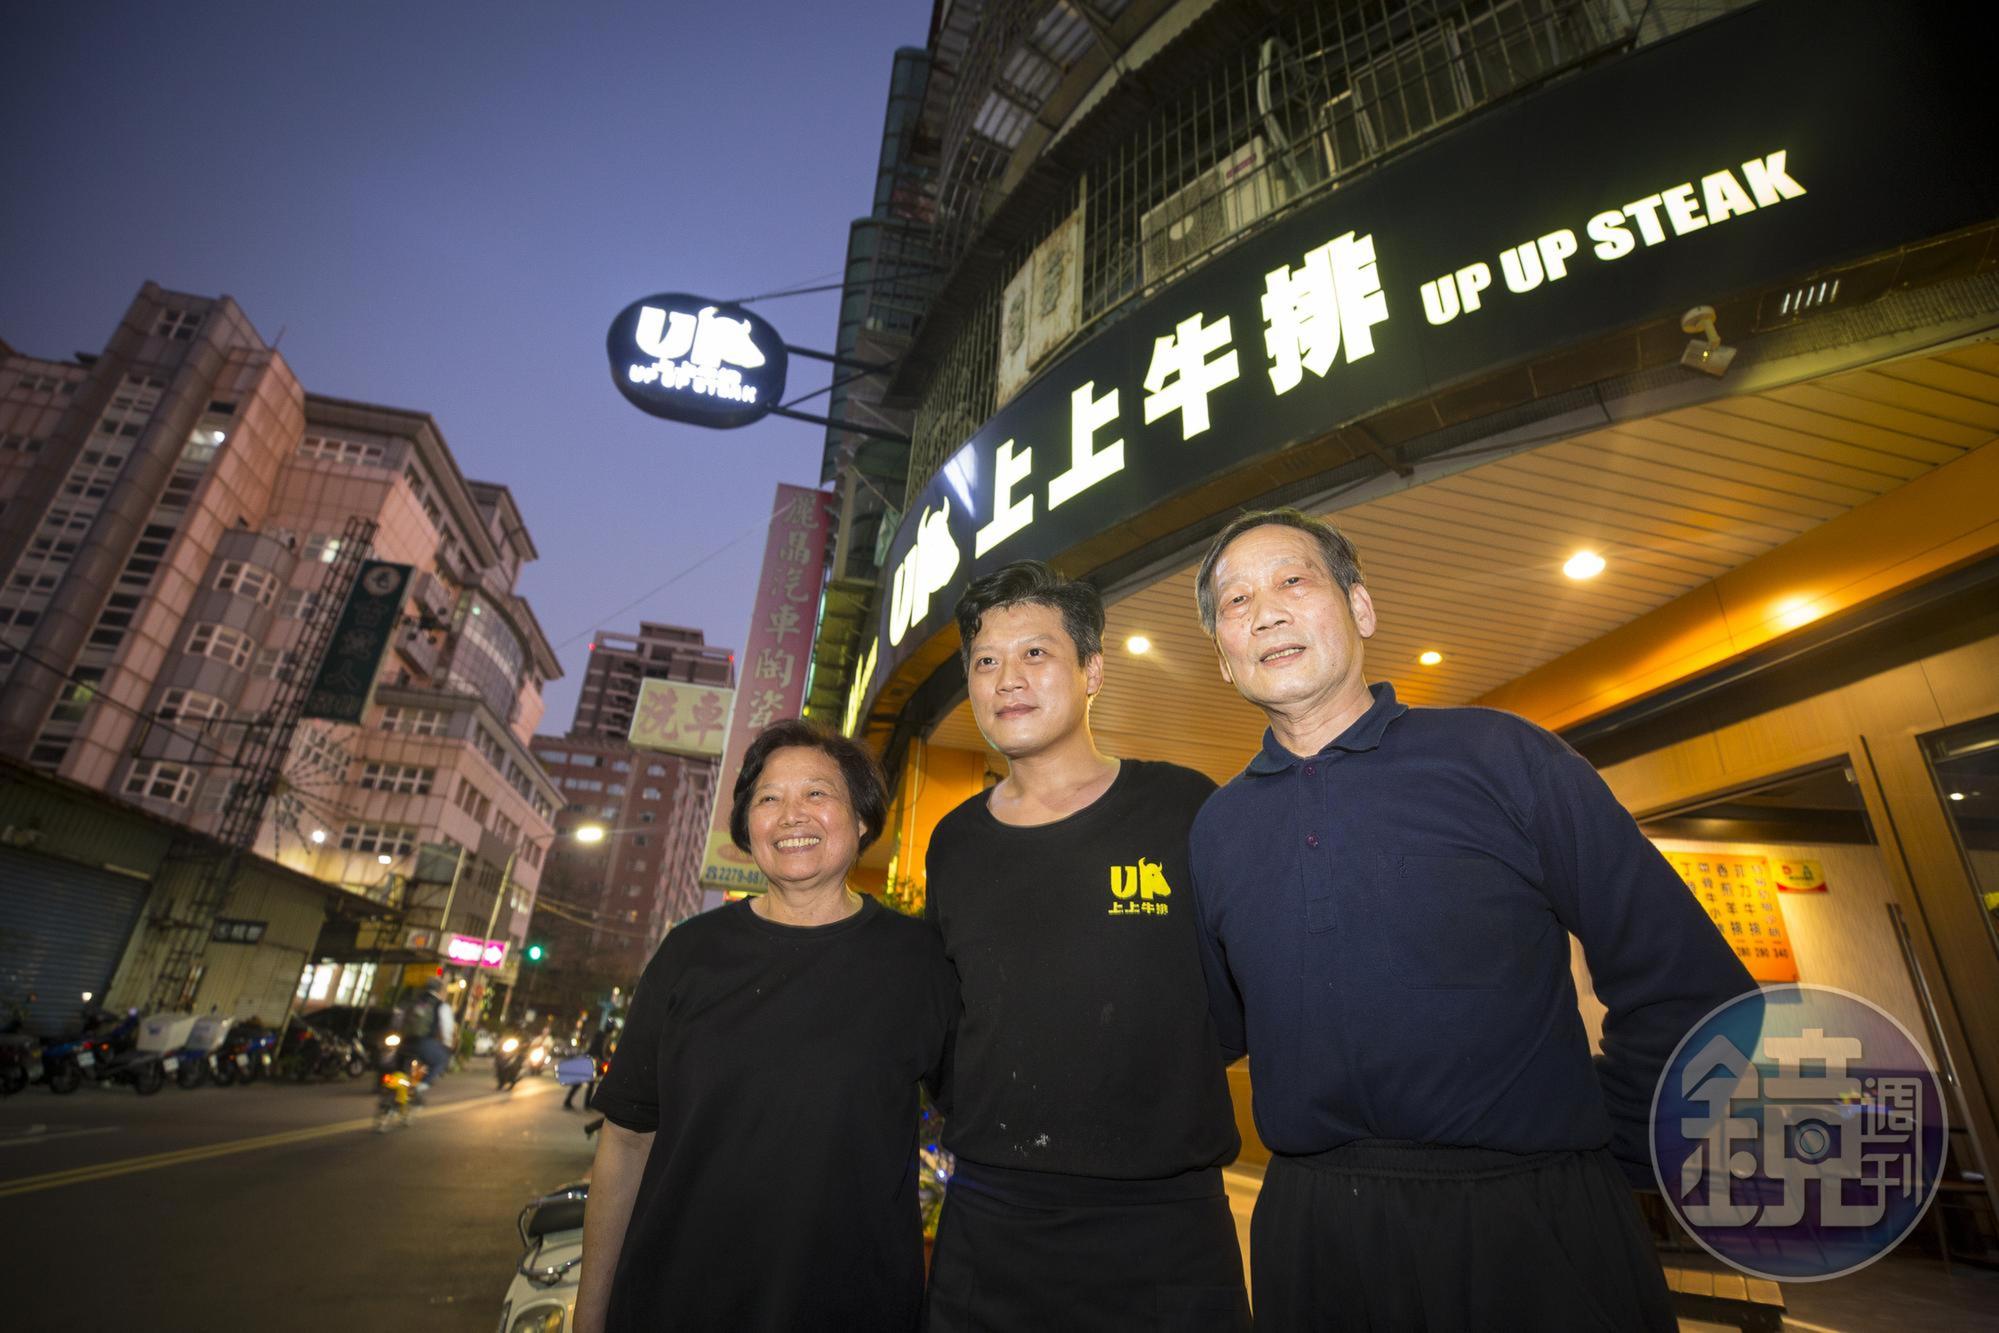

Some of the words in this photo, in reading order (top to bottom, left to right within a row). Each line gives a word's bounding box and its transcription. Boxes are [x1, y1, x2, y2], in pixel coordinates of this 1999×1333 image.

[1420, 262, 1493, 326] UP
[1499, 229, 1579, 294] UP
[1586, 150, 1807, 261] STEAK
[974, 230, 1390, 560] 上上牛排
[741, 491, 820, 745] 麗晶汽車陶瓷
[640, 687, 724, 746] 洗車
[1107, 901, 1169, 916] 上上牛排
